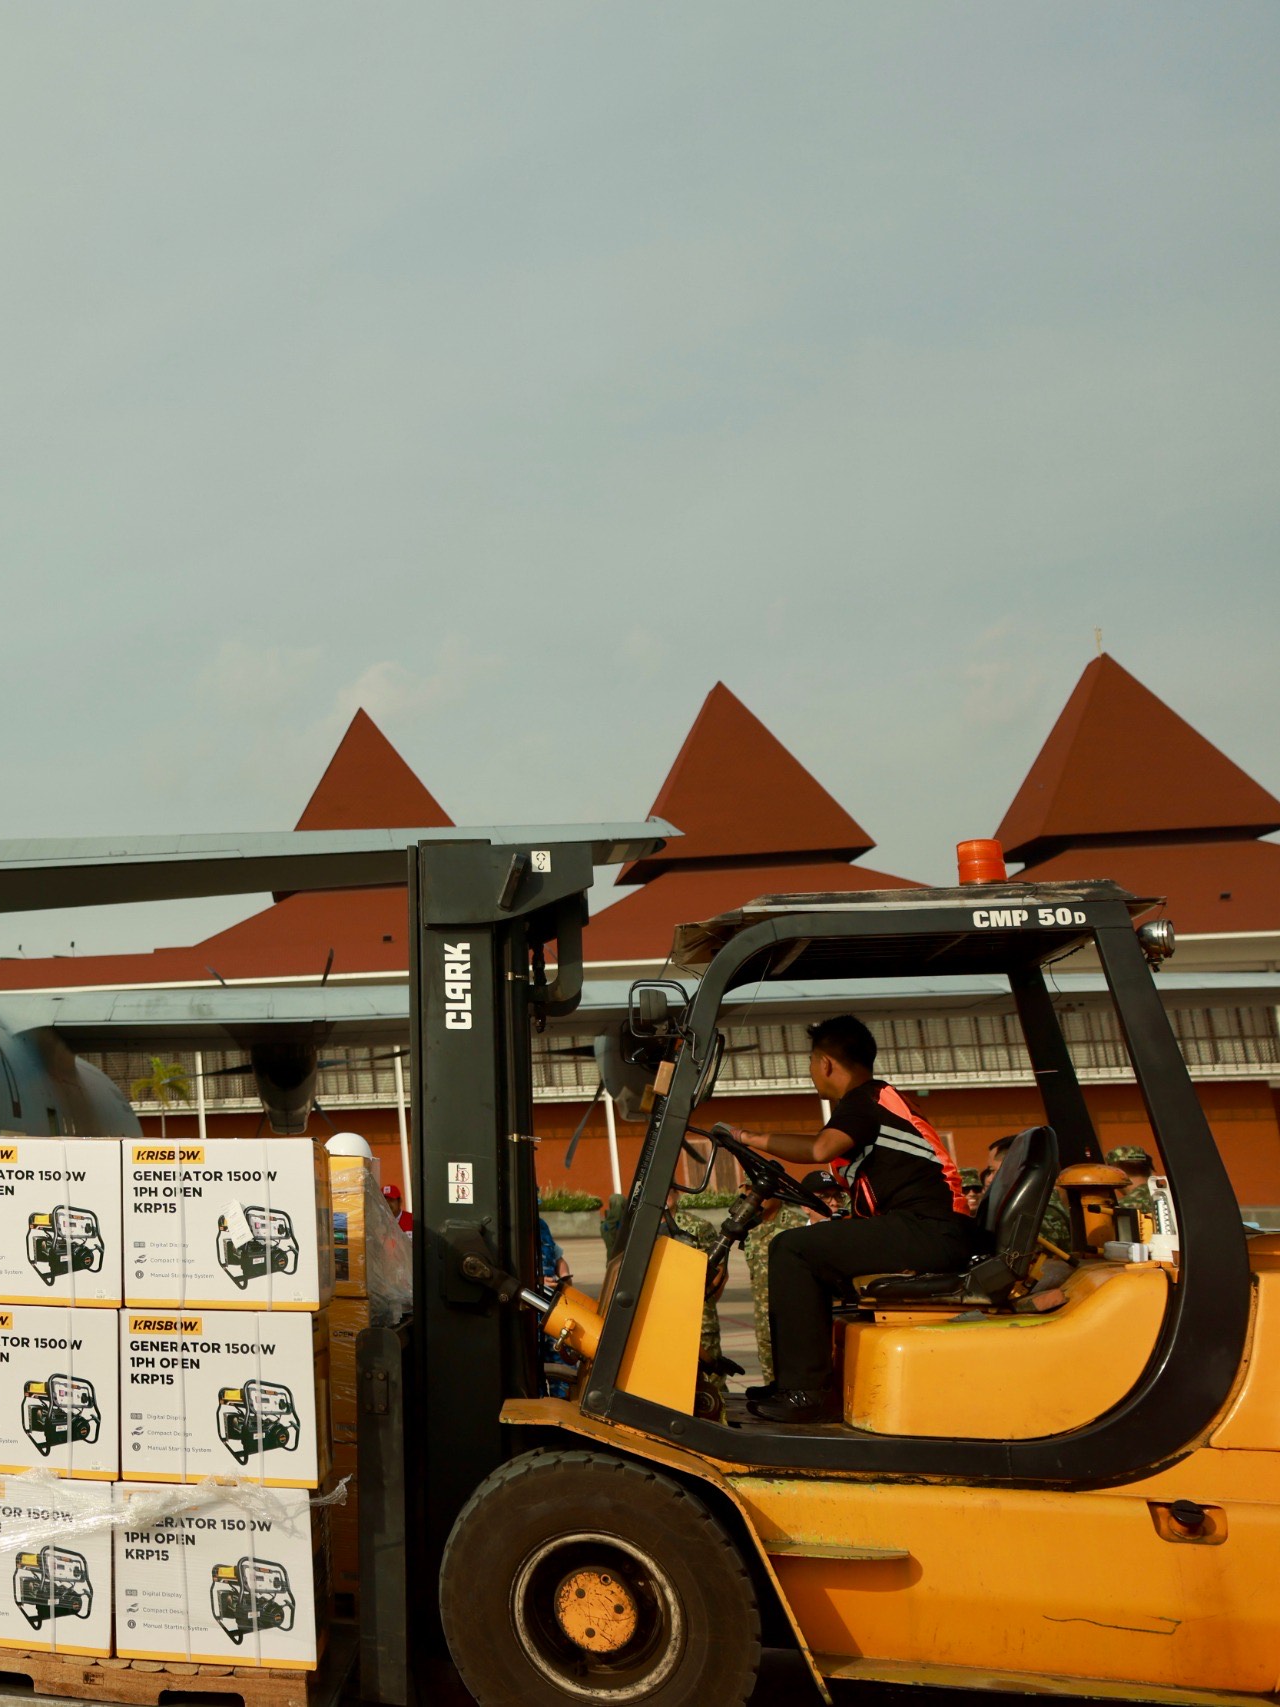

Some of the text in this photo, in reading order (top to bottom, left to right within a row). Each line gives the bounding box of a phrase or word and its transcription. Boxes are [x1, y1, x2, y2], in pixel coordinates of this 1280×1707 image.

[972, 909, 1029, 928] CMP
[443, 942, 473, 1030] CLARK
[136, 1150, 200, 1161] KRISBOW
[38, 1170, 86, 1182] 1500W
[227, 1170, 278, 1182] 1500W
[133, 1186, 158, 1197] 1PH
[133, 1202, 177, 1213] KRP15
[133, 1320, 198, 1332] KRISBOW
[34, 1337, 83, 1350] 1500W
[130, 1340, 276, 1356] GENERATOR 1500W
[130, 1356, 200, 1370] 1PH OPEN
[130, 1373, 174, 1385] KRP15
[151, 1517, 272, 1532] ERATOR 1500W
[124, 1531, 196, 1546] 1PH OPEN
[125, 1548, 170, 1561] KRP15
[161, 1591, 182, 1599] Display
